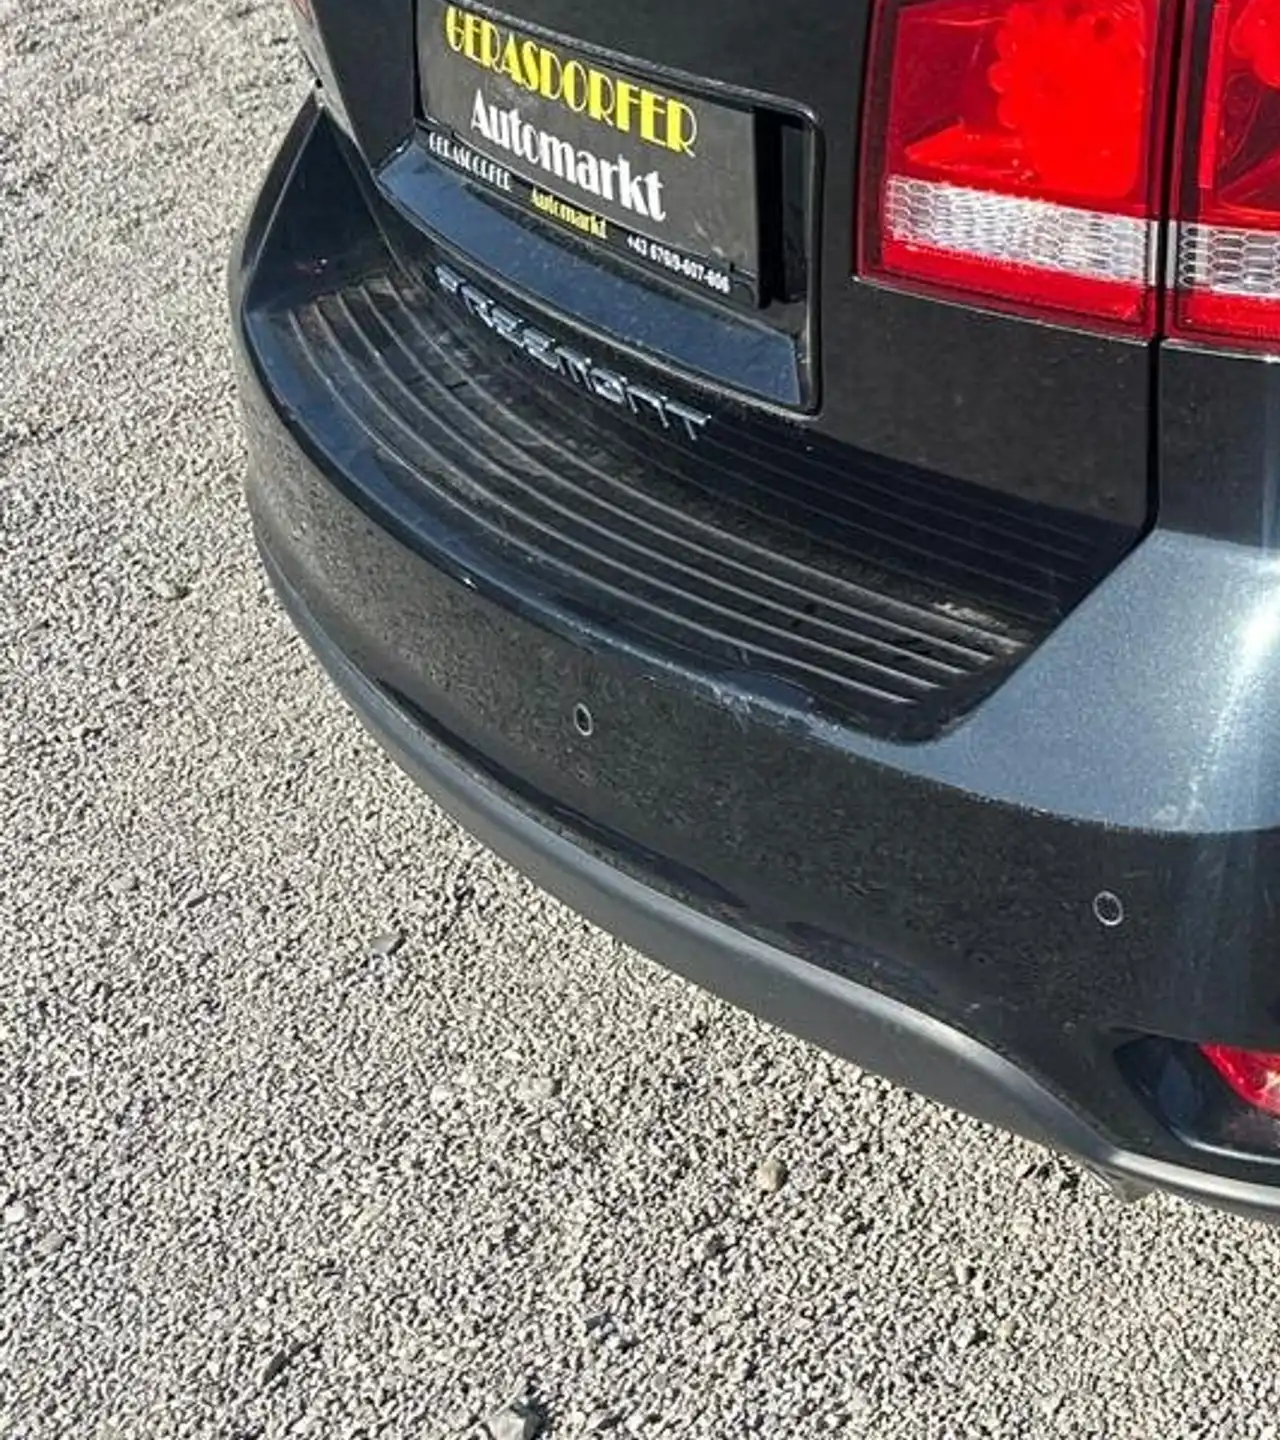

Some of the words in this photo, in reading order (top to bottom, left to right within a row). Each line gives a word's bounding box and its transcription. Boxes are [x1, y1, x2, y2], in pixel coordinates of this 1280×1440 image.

[445, 6, 698, 158] GERASDORFER
[470, 89, 666, 222] Automarkt
[531, 186, 608, 239] Automarkt
